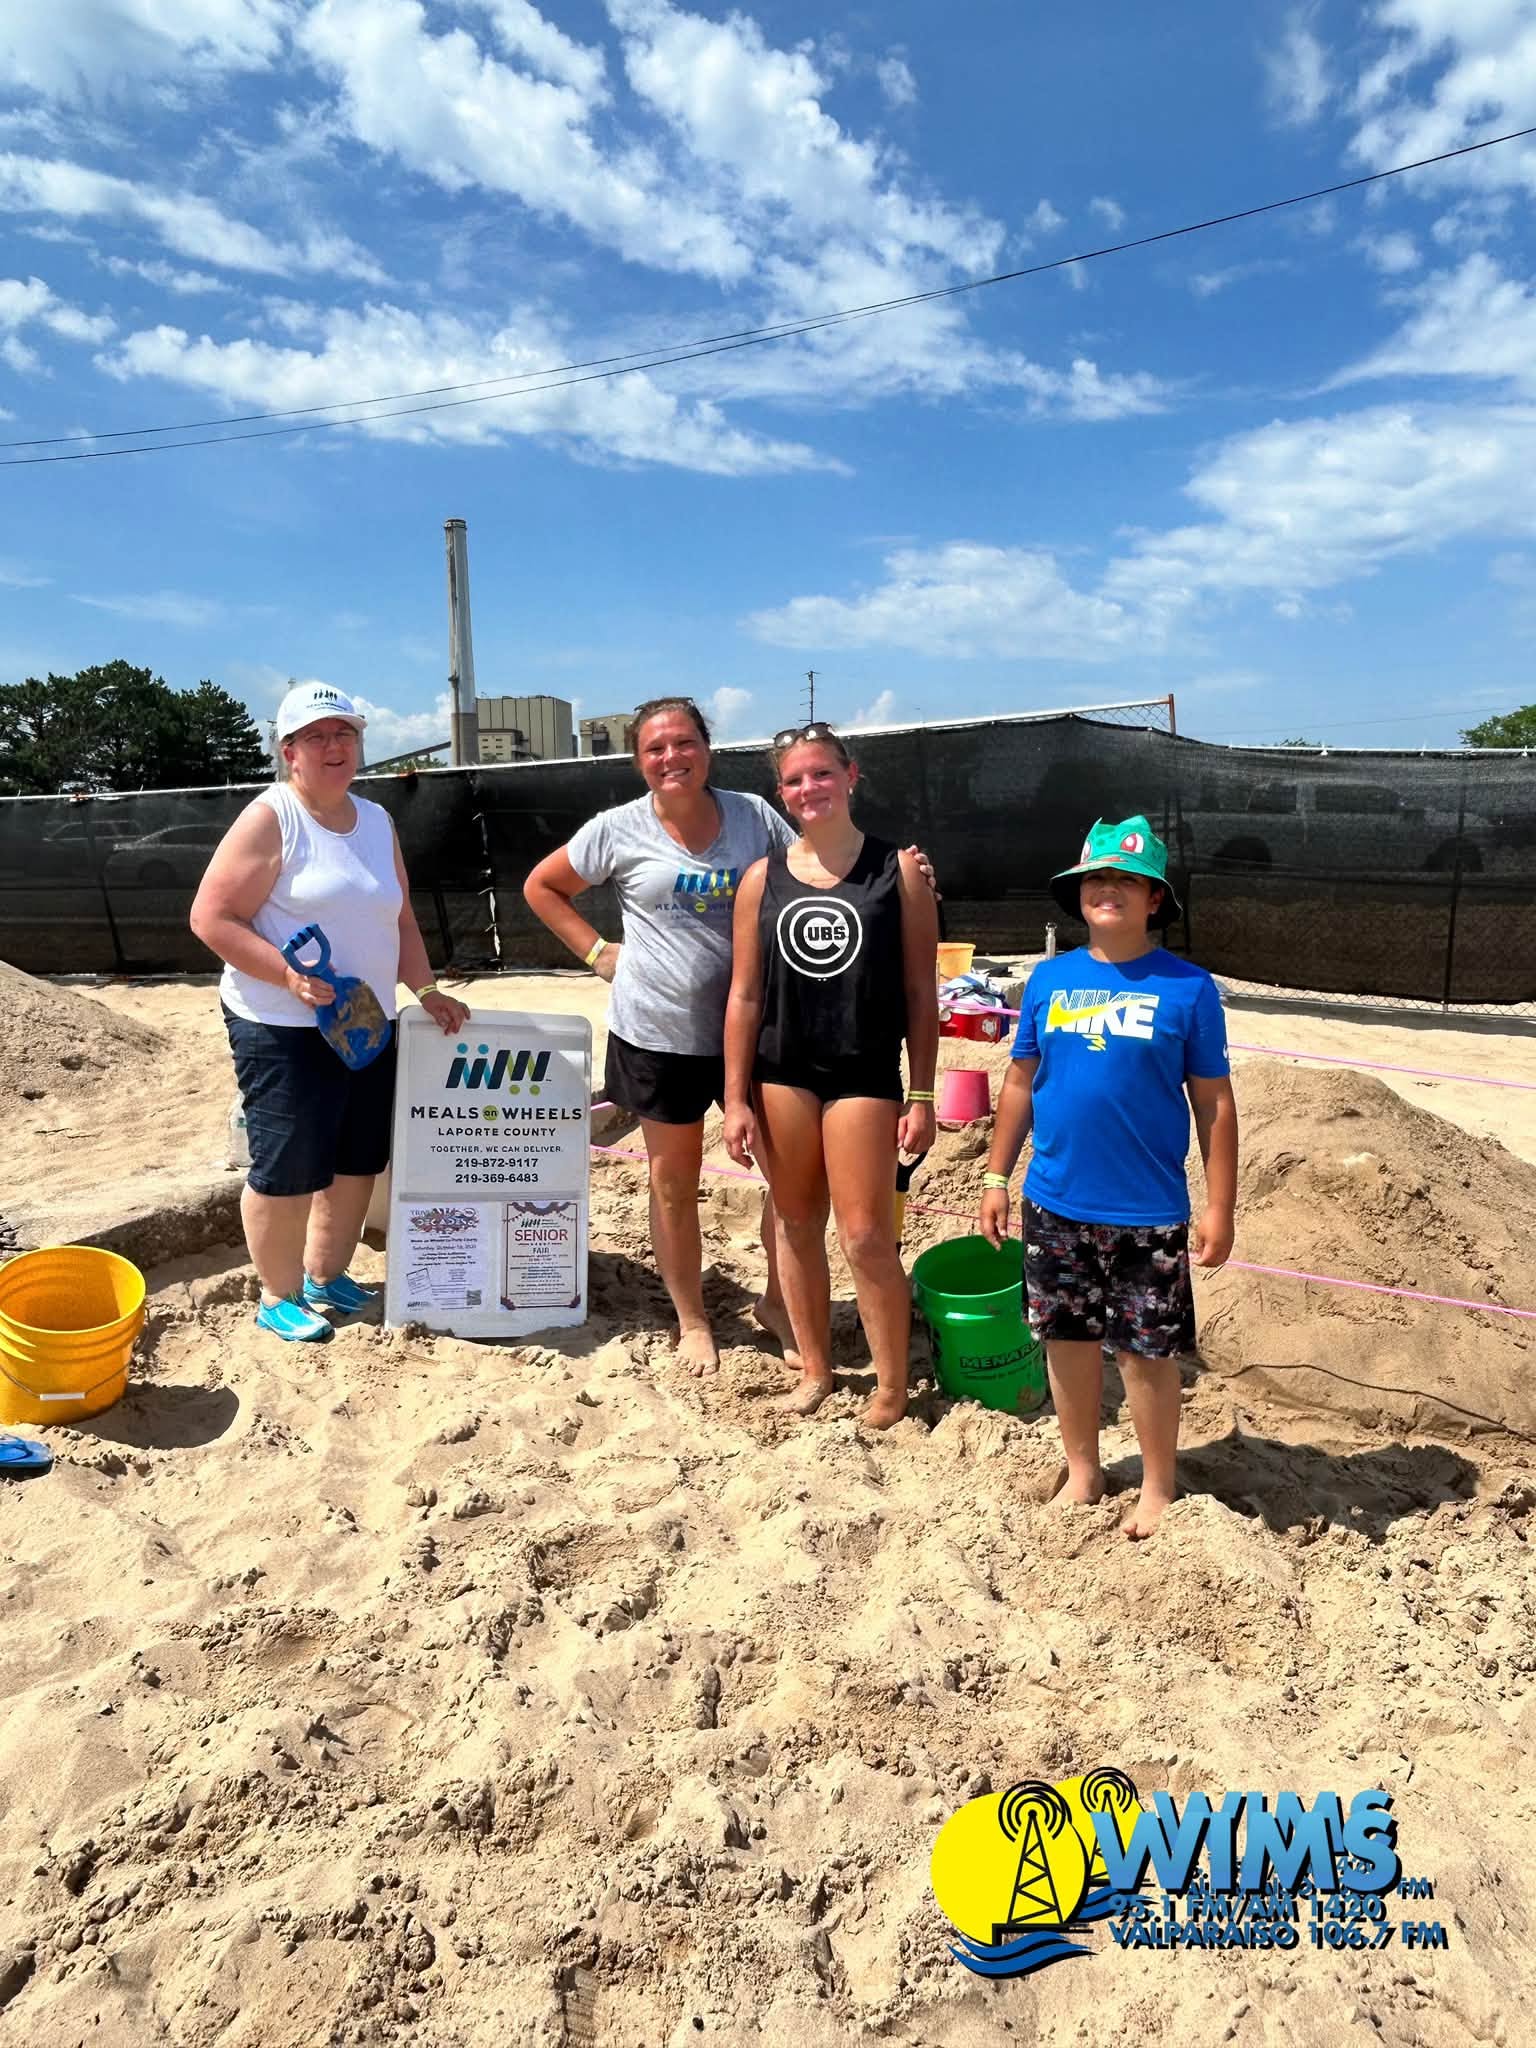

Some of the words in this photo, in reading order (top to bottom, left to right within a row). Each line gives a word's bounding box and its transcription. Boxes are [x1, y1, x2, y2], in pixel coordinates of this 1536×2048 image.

[1045, 989, 1160, 1040] NIKE
[411, 1106, 479, 1119] MEALS
[502, 1107, 582, 1120] WHEELS
[438, 1127, 499, 1137] LAPORTE
[503, 1127, 556, 1137] COUNTY
[455, 1158, 539, 1168] 219-872-9117
[455, 1174, 539, 1183] 219-369-6483
[515, 1229, 569, 1242] SENIOR
